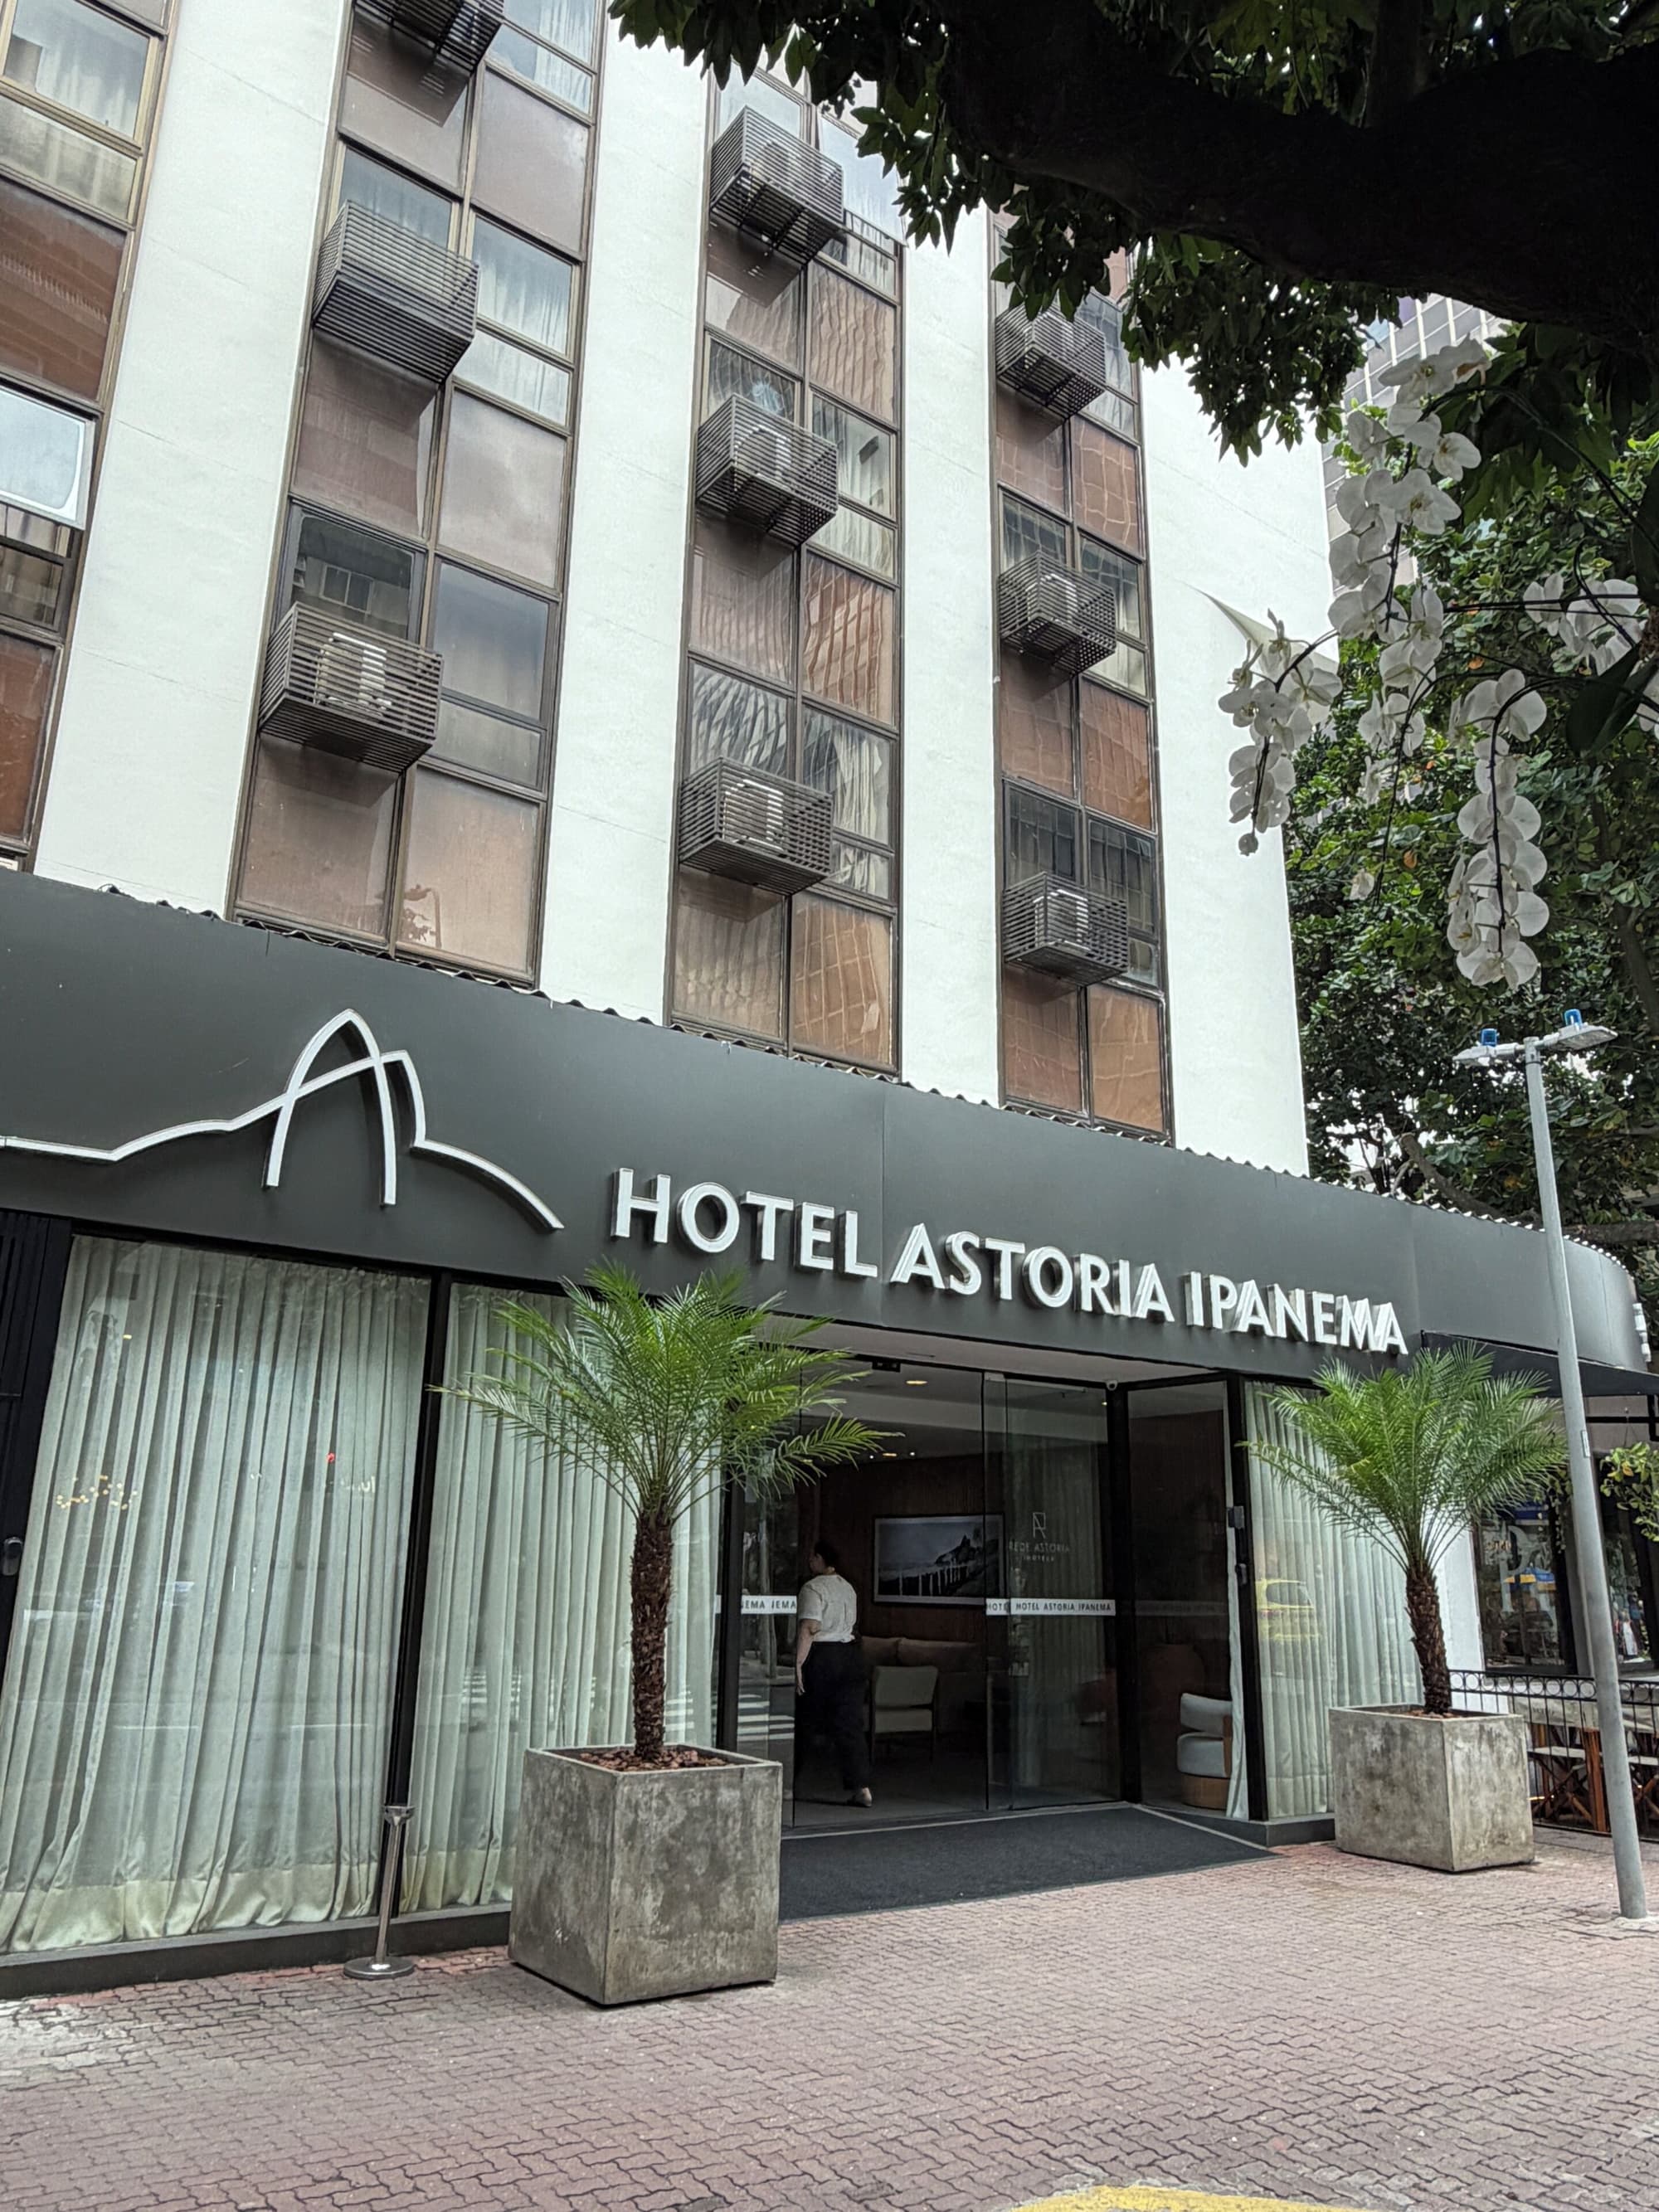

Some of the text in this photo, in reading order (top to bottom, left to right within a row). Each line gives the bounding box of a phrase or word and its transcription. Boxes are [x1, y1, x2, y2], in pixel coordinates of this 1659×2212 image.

[611, 1167, 1408, 1355] HOTEL ASTORIA IPANEMA
[1034, 1543, 1070, 1553] ASTORIA
[1016, 1602, 1112, 1612] HOTEL ASTORIA IPANEMA
